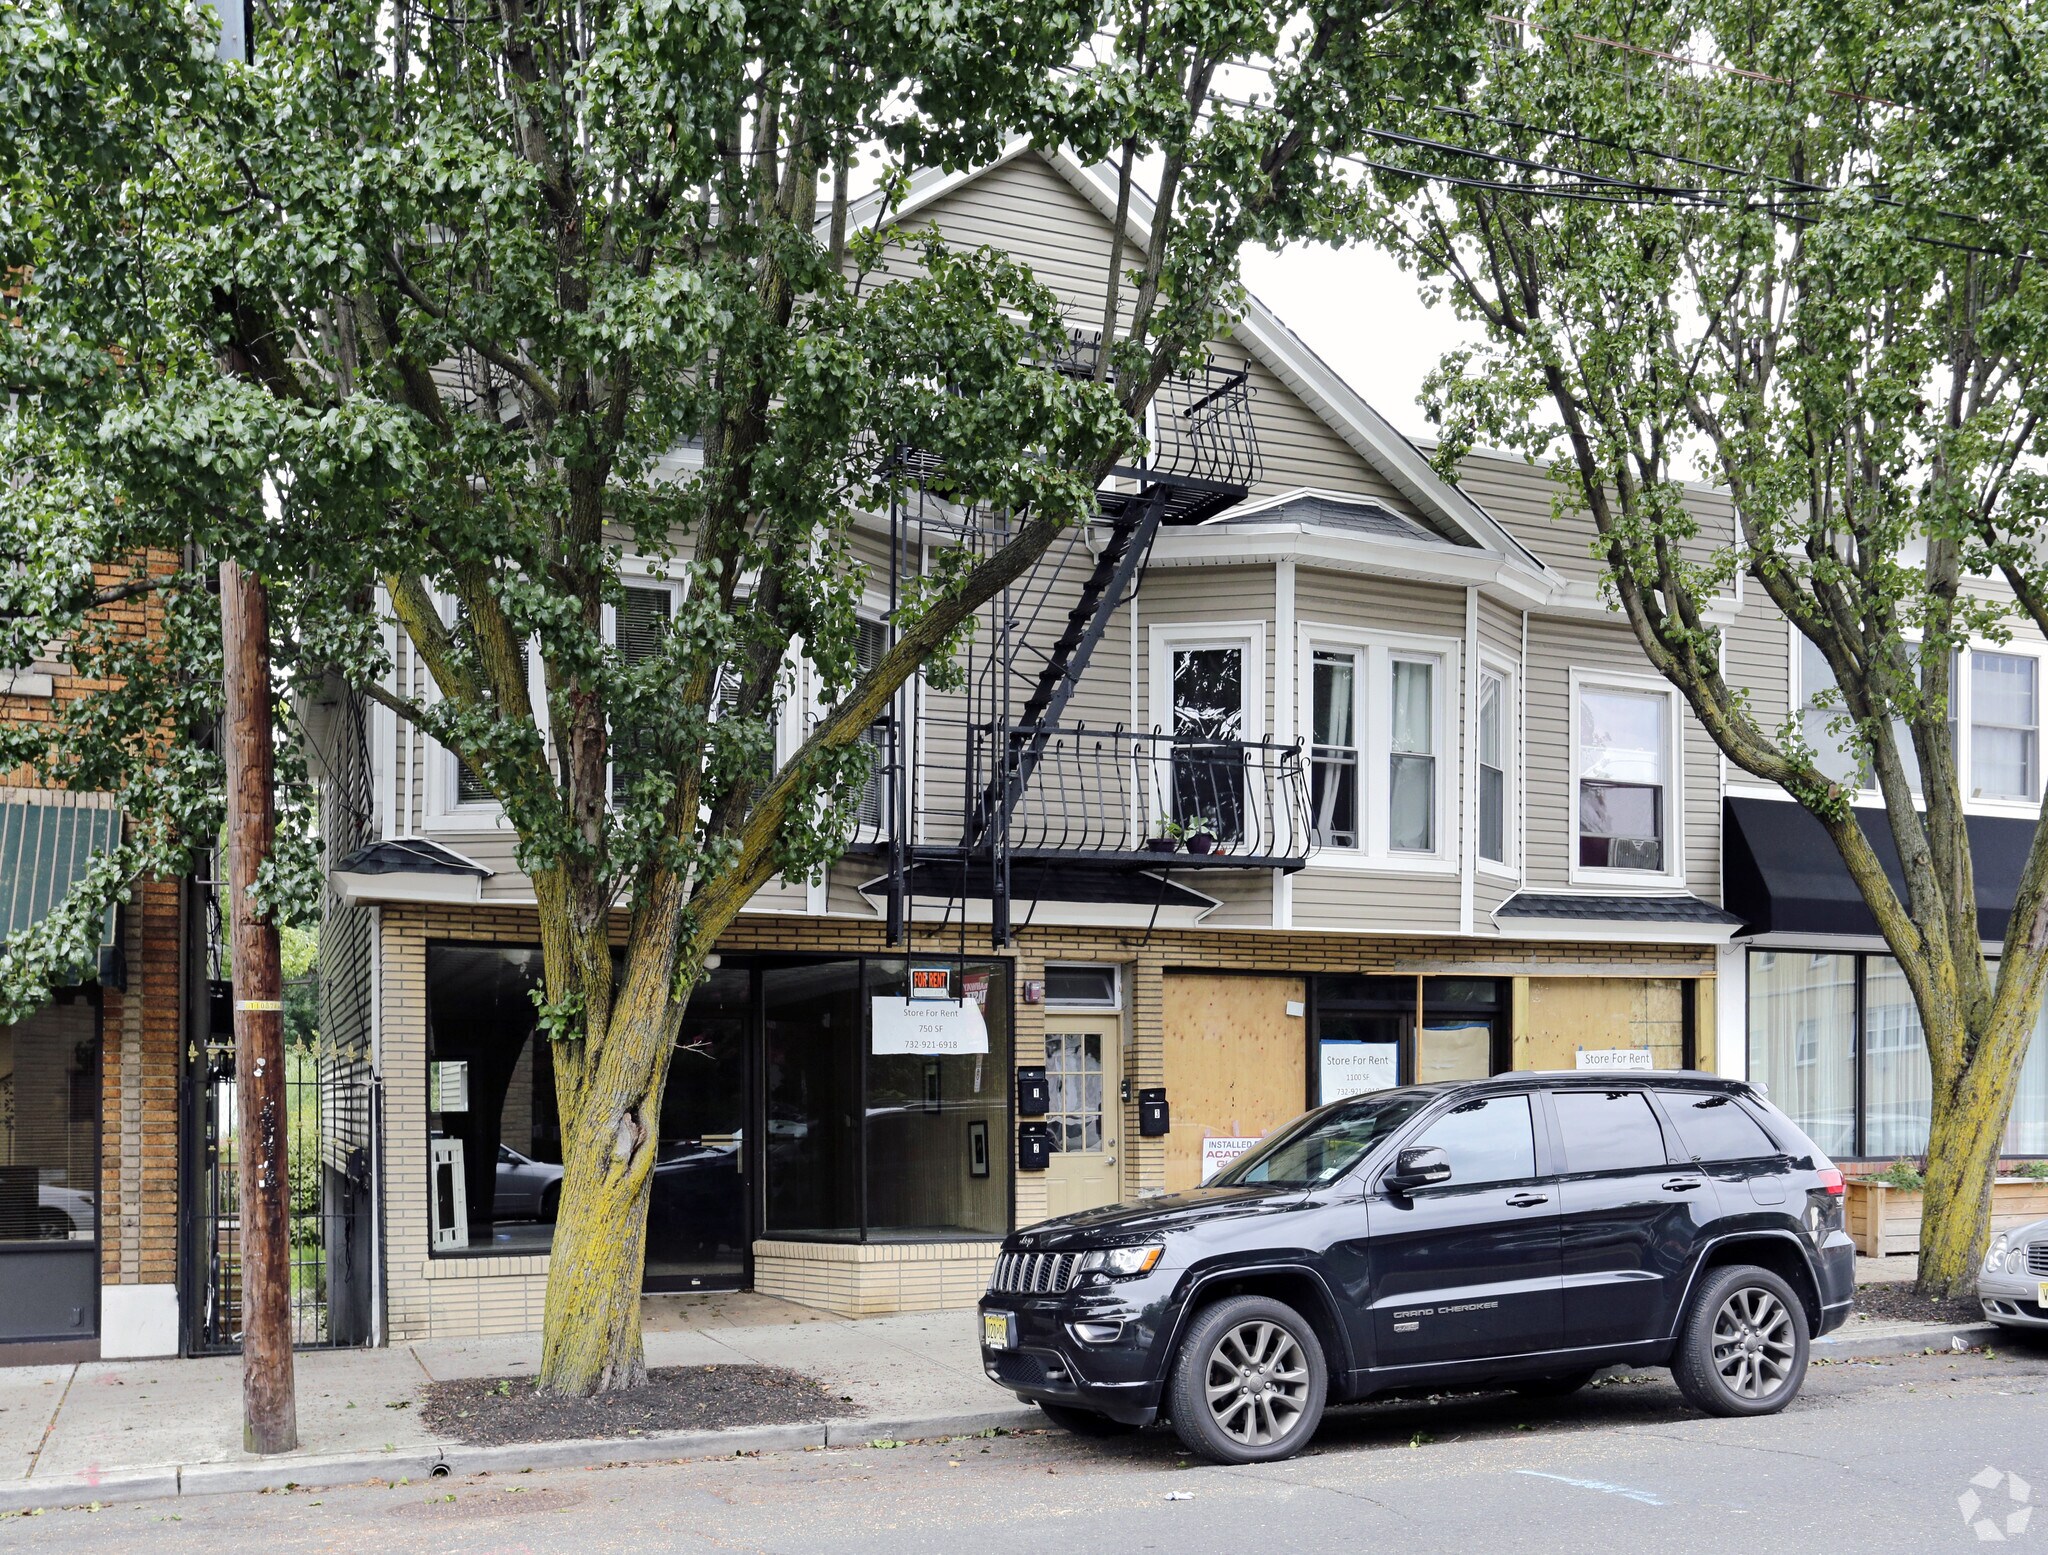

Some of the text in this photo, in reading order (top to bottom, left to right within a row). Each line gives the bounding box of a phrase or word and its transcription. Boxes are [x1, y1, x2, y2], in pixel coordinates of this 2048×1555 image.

[914, 972, 946, 988] FOR RENT
[903, 1008, 958, 1018] Store For Rent
[919, 1024, 944, 1033] 750 SF
[904, 1040, 958, 1049] 732-921-6918
[1326, 1055, 1389, 1066] Store For Rent
[1584, 1053, 1650, 1065] Store For Rent
[1346, 1073, 1370, 1081] 1100 SF
[1208, 1140, 1253, 1149] INSTALLED
[1206, 1150, 1245, 1159] ACAD
[1393, 1301, 1499, 1319] GRAND CHEROKEE
